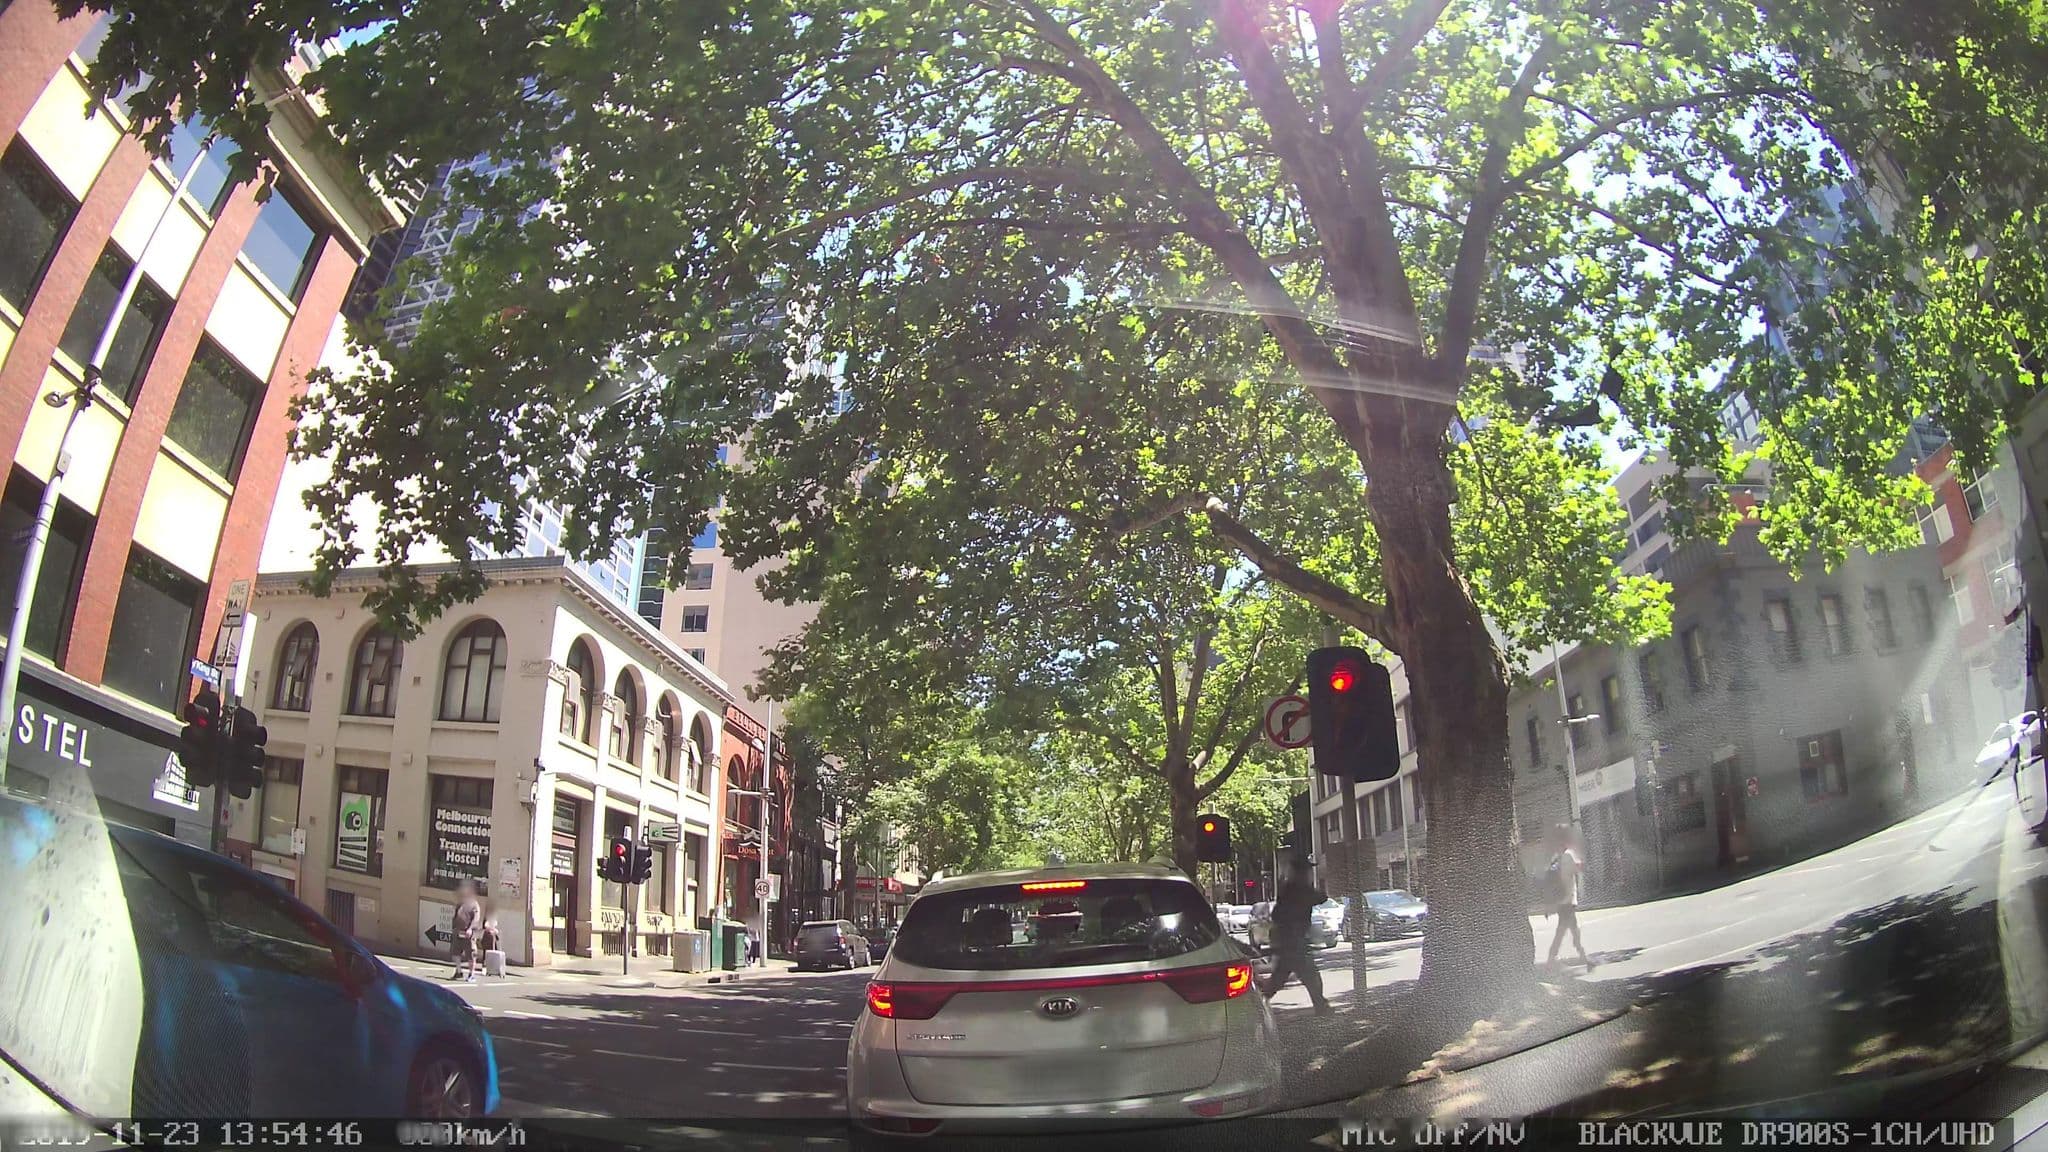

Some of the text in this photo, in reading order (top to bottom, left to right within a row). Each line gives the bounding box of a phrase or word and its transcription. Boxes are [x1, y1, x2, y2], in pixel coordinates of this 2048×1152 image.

[439, 837, 489, 856] Travellers
[446, 851, 480, 865] Hostel
[757, 885, 768, 893] 40
[1048, 1001, 1072, 1011] KIA
